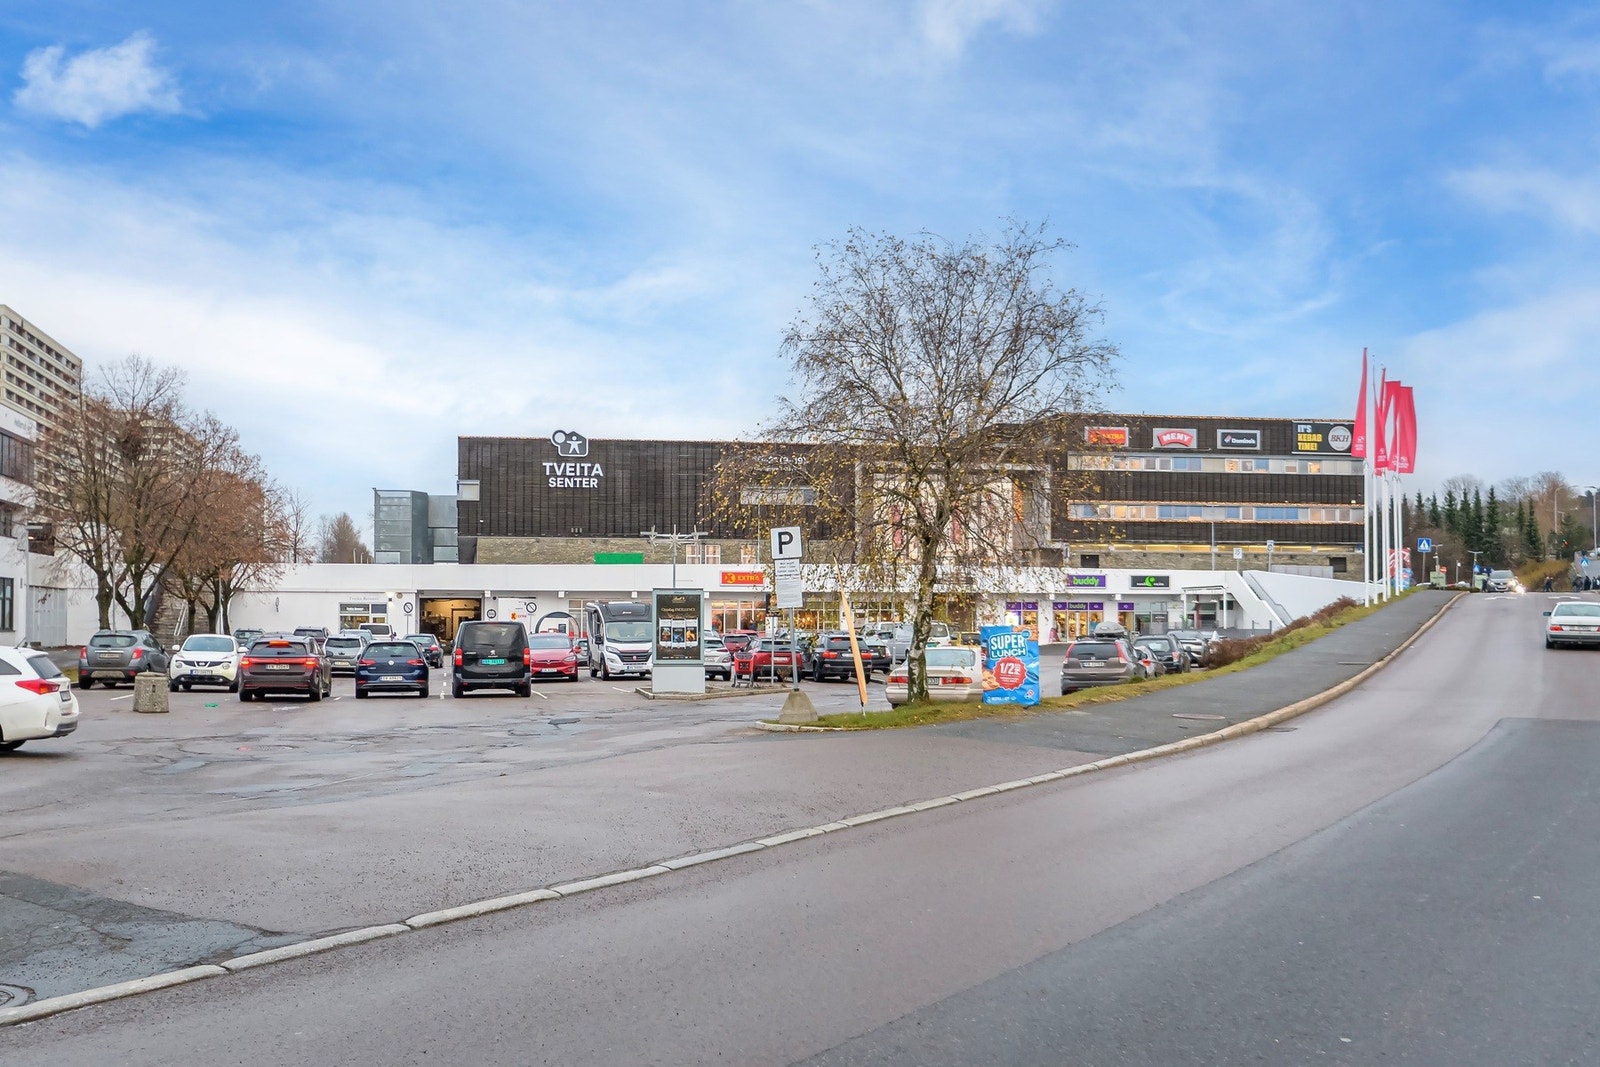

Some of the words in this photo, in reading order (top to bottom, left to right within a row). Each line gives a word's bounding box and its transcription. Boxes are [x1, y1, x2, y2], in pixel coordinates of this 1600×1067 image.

[1297, 424, 1312, 433] IT'S
[1162, 432, 1191, 443] MENY
[1297, 434, 1322, 442] KEBAB
[1330, 434, 1350, 442] BKH
[1297, 442, 1318, 451] TIME!
[542, 462, 604, 477] TVEITA
[548, 476, 598, 488] SENTER
[778, 531, 794, 555] P
[1073, 576, 1099, 586] buddy
[991, 634, 1025, 650] SUPER
[991, 649, 1025, 658] LUNCH
[1000, 662, 1014, 674] 1/2
